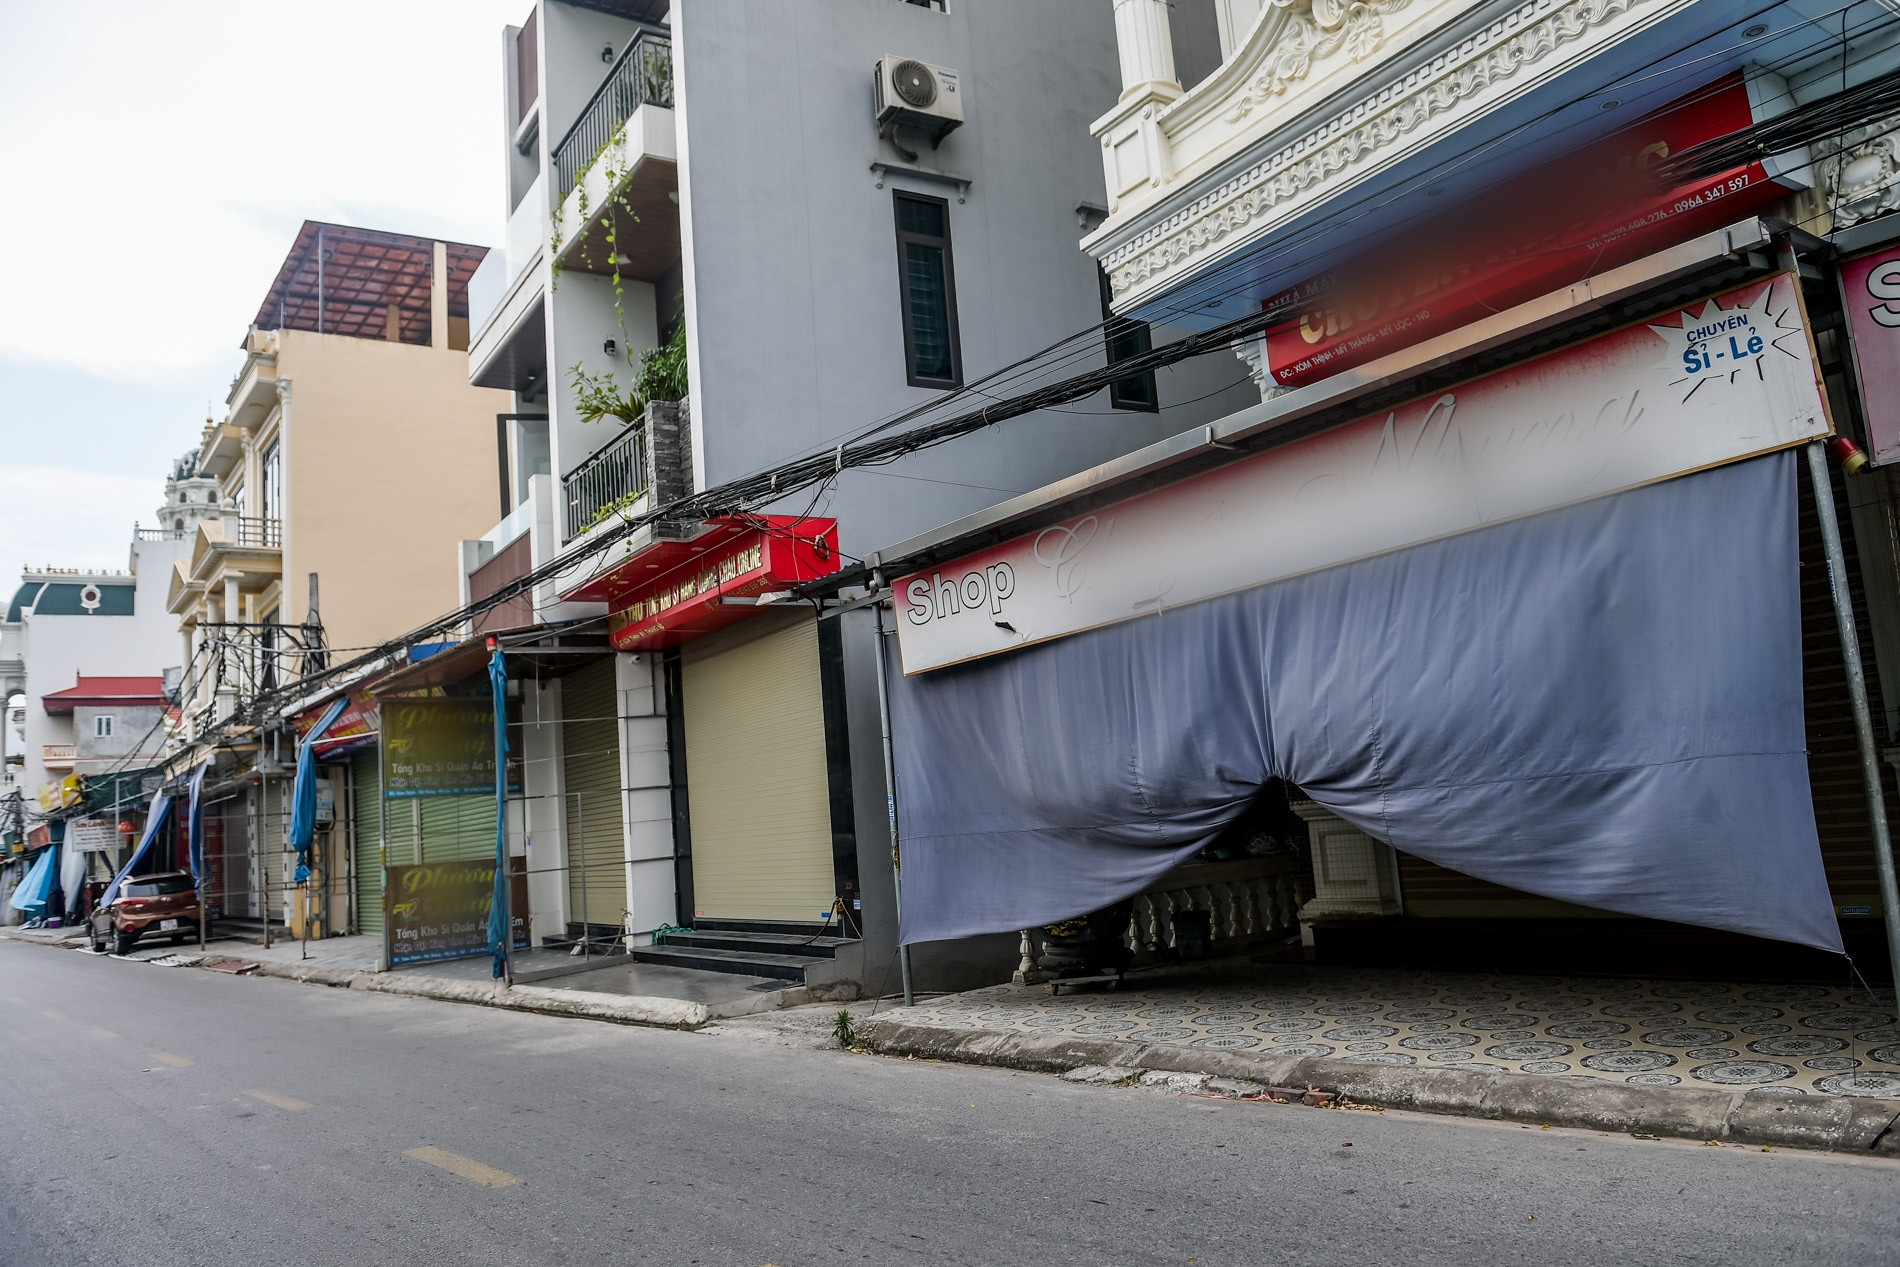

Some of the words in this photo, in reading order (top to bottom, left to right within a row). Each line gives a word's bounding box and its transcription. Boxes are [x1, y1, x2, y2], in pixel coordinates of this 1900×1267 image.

[1648, 209, 1667, 224] 276
[1674, 193, 1703, 213] 0964
[1704, 184, 1726, 201] 347
[1728, 174, 1750, 191] 597
[1293, 360, 1312, 375] XÓM
[1311, 352, 1333, 366] THỊNH
[1335, 343, 1348, 356] MỸ
[1379, 324, 1393, 338] MỸ
[1682, 343, 1711, 374] Sỉ
[1729, 326, 1764, 360] Lẻ
[1686, 313, 1749, 343] CHUYÊN
[906, 562, 1015, 625] Shop
[416, 761, 432, 772] Kho
[420, 925, 438, 937] Kho
